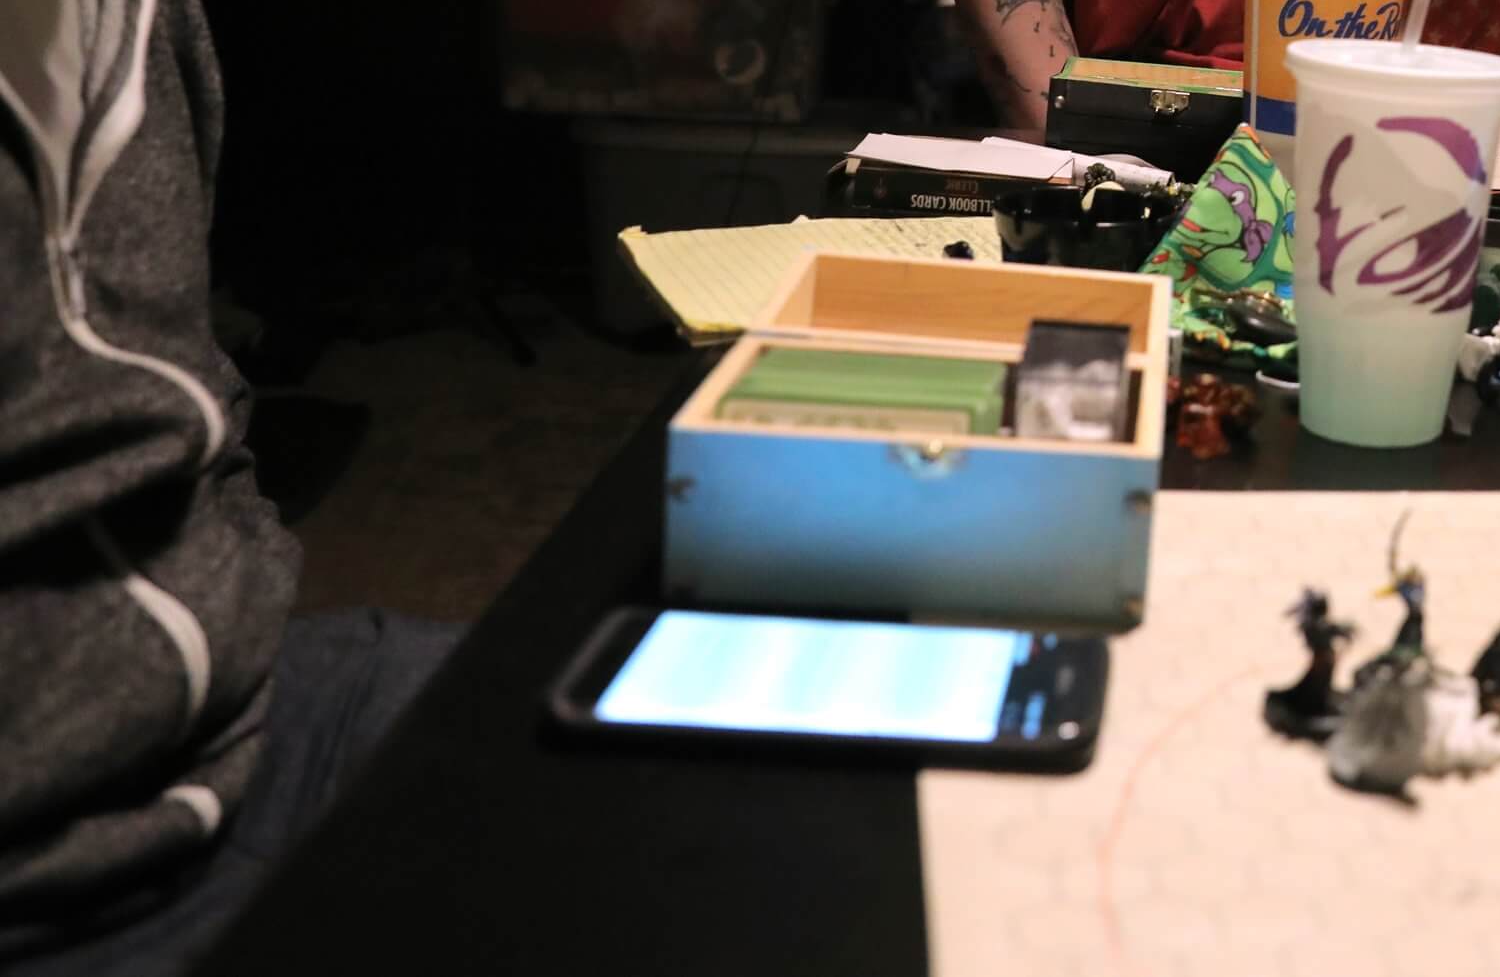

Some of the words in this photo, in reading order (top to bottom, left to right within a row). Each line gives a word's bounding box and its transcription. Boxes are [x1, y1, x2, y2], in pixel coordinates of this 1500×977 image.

[1333, 1, 1379, 40] the
[910, 194, 947, 210] CARDS
[949, 197, 994, 213] LLBOOK
